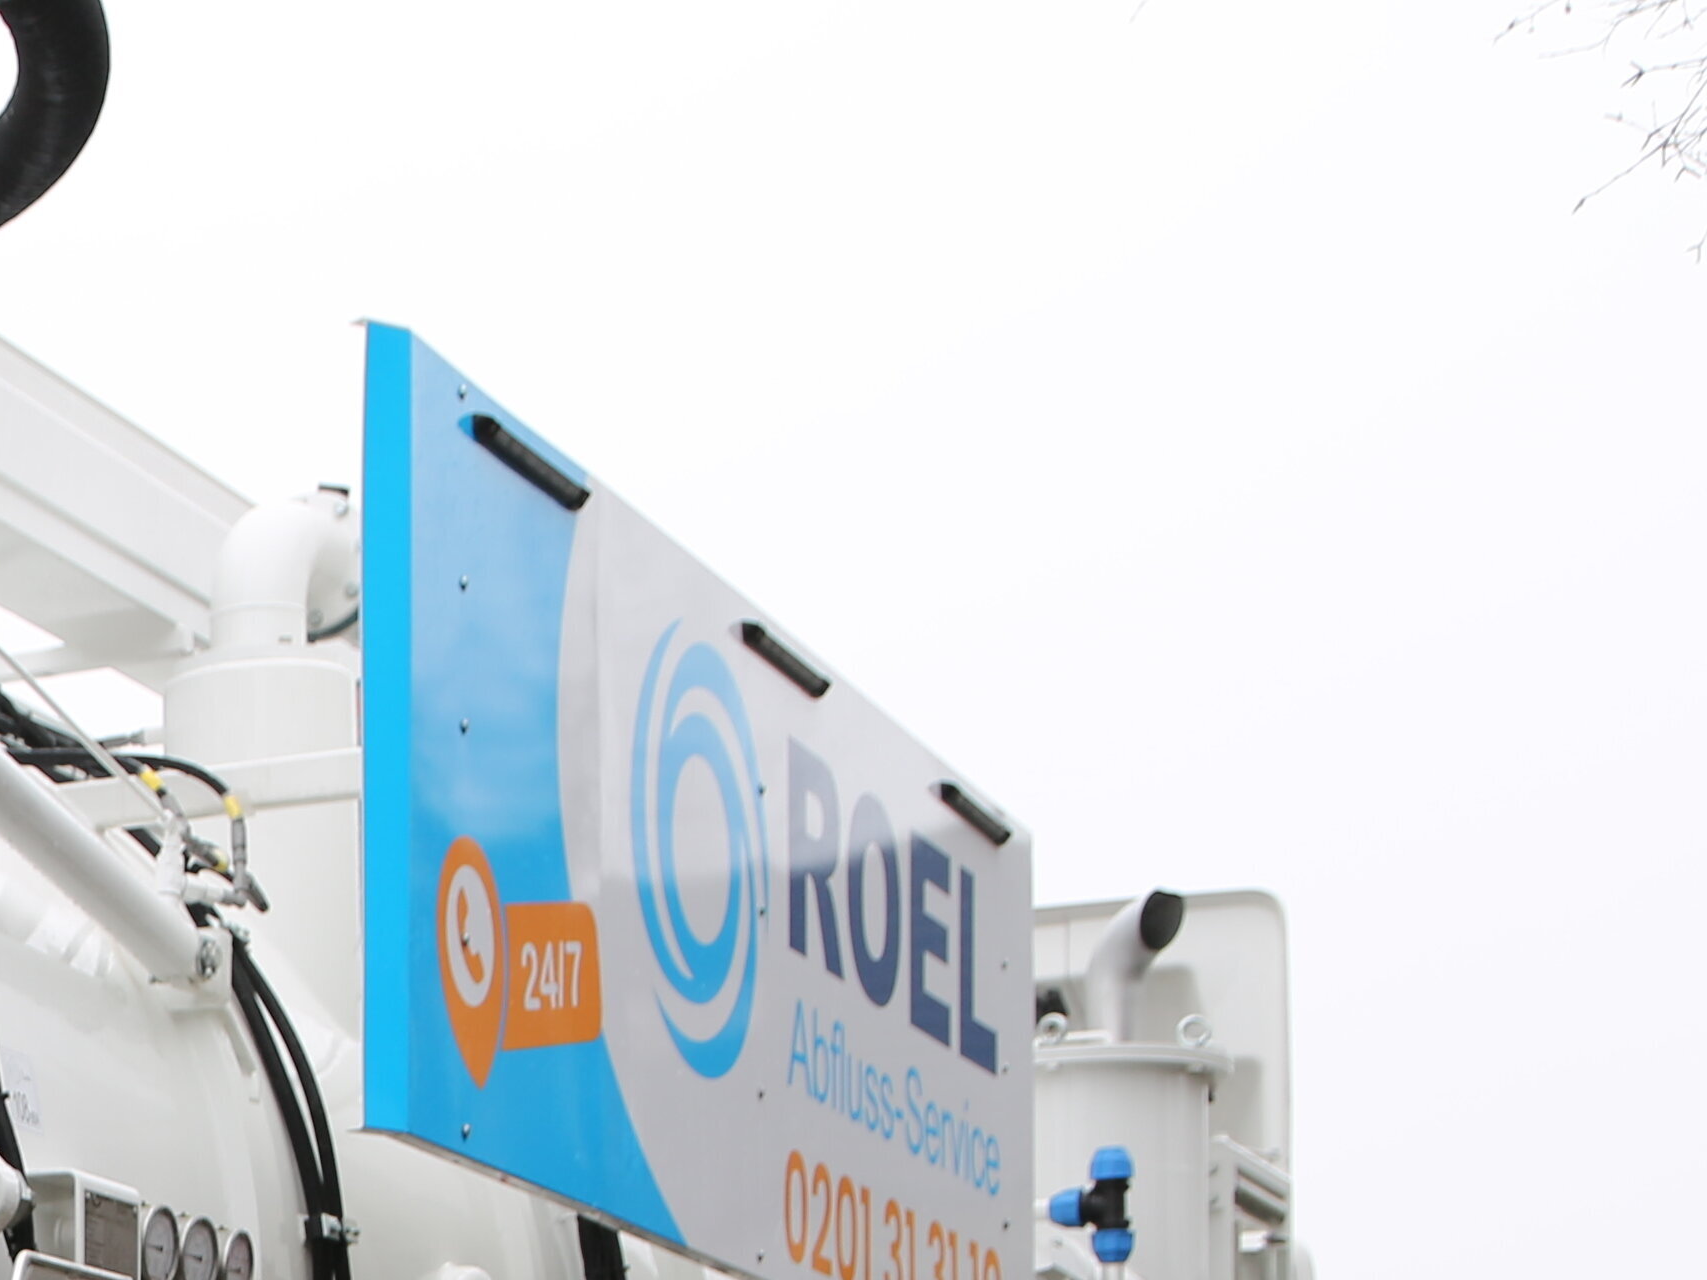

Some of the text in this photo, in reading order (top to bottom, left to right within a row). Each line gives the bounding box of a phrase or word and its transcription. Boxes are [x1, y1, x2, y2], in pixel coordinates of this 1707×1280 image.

[520, 940, 583, 1011] 24/7
[787, 735, 999, 1077] ROEL
[788, 999, 1001, 1196] Abfluss-Service
